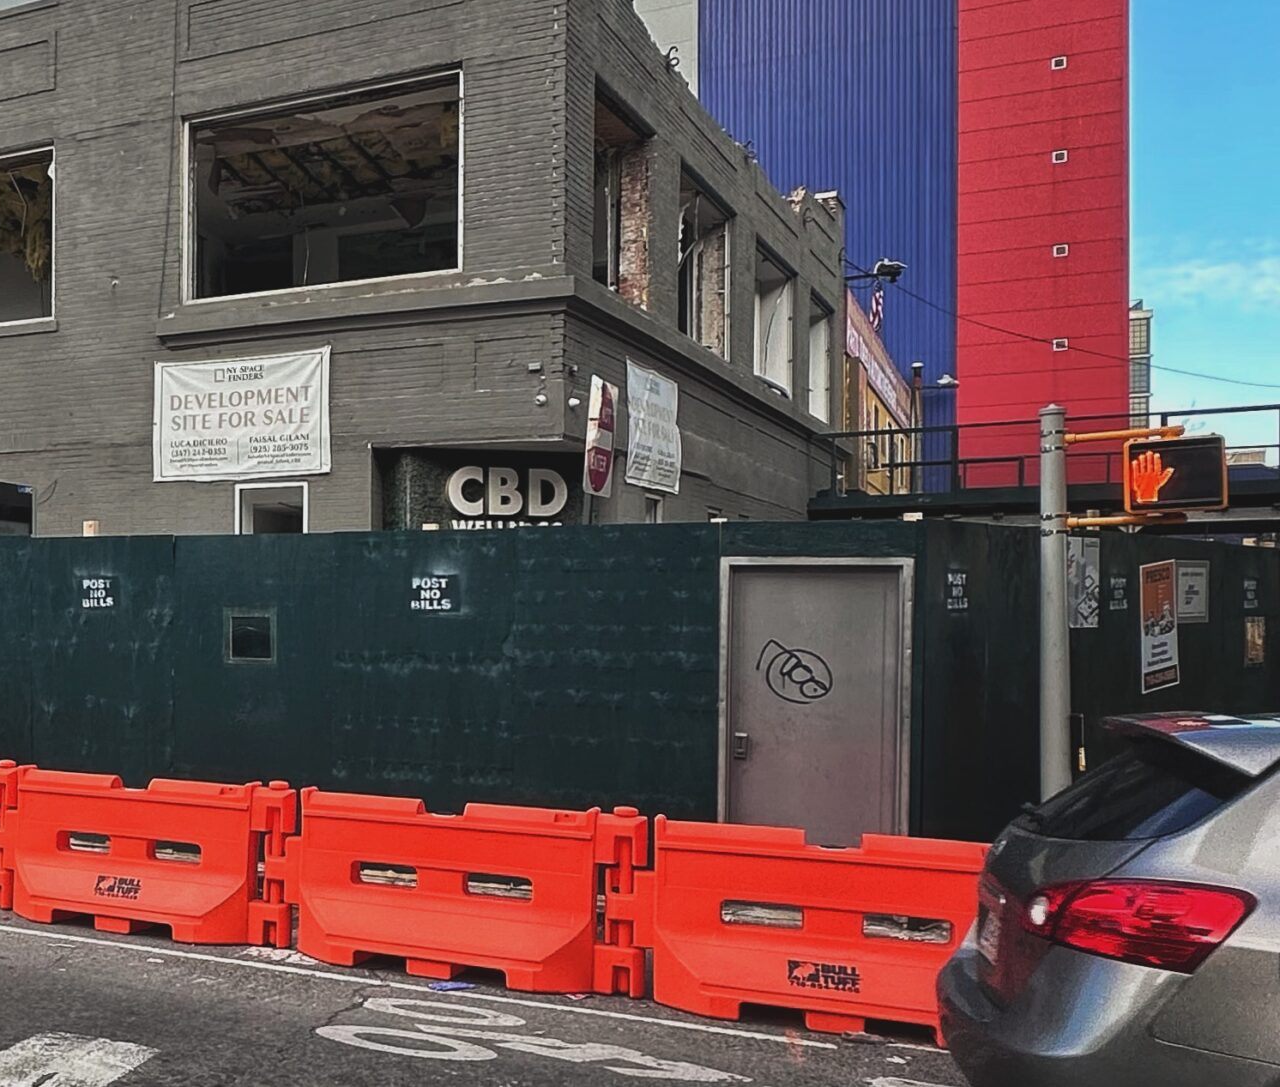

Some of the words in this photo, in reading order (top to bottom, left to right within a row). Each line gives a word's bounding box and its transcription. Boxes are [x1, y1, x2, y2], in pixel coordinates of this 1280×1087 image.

[228, 372, 264, 382] FINDERS
[170, 385, 312, 411] DEVELOPMENT
[171, 414, 212, 431] SITE
[218, 411, 256, 428] FOR
[262, 407, 310, 426] SALE
[446, 465, 568, 517] CBD
[82, 578, 112, 590] POST
[411, 577, 448, 589] POST
[89, 589, 106, 598] NO
[420, 589, 441, 600] NO
[81, 596, 114, 608] BILLS
[410, 598, 452, 610] BILLS
[117, 878, 141, 888] BULL
[117, 885, 141, 895] TUFF
[821, 963, 860, 977] BULL
[821, 974, 863, 988] TUFF
